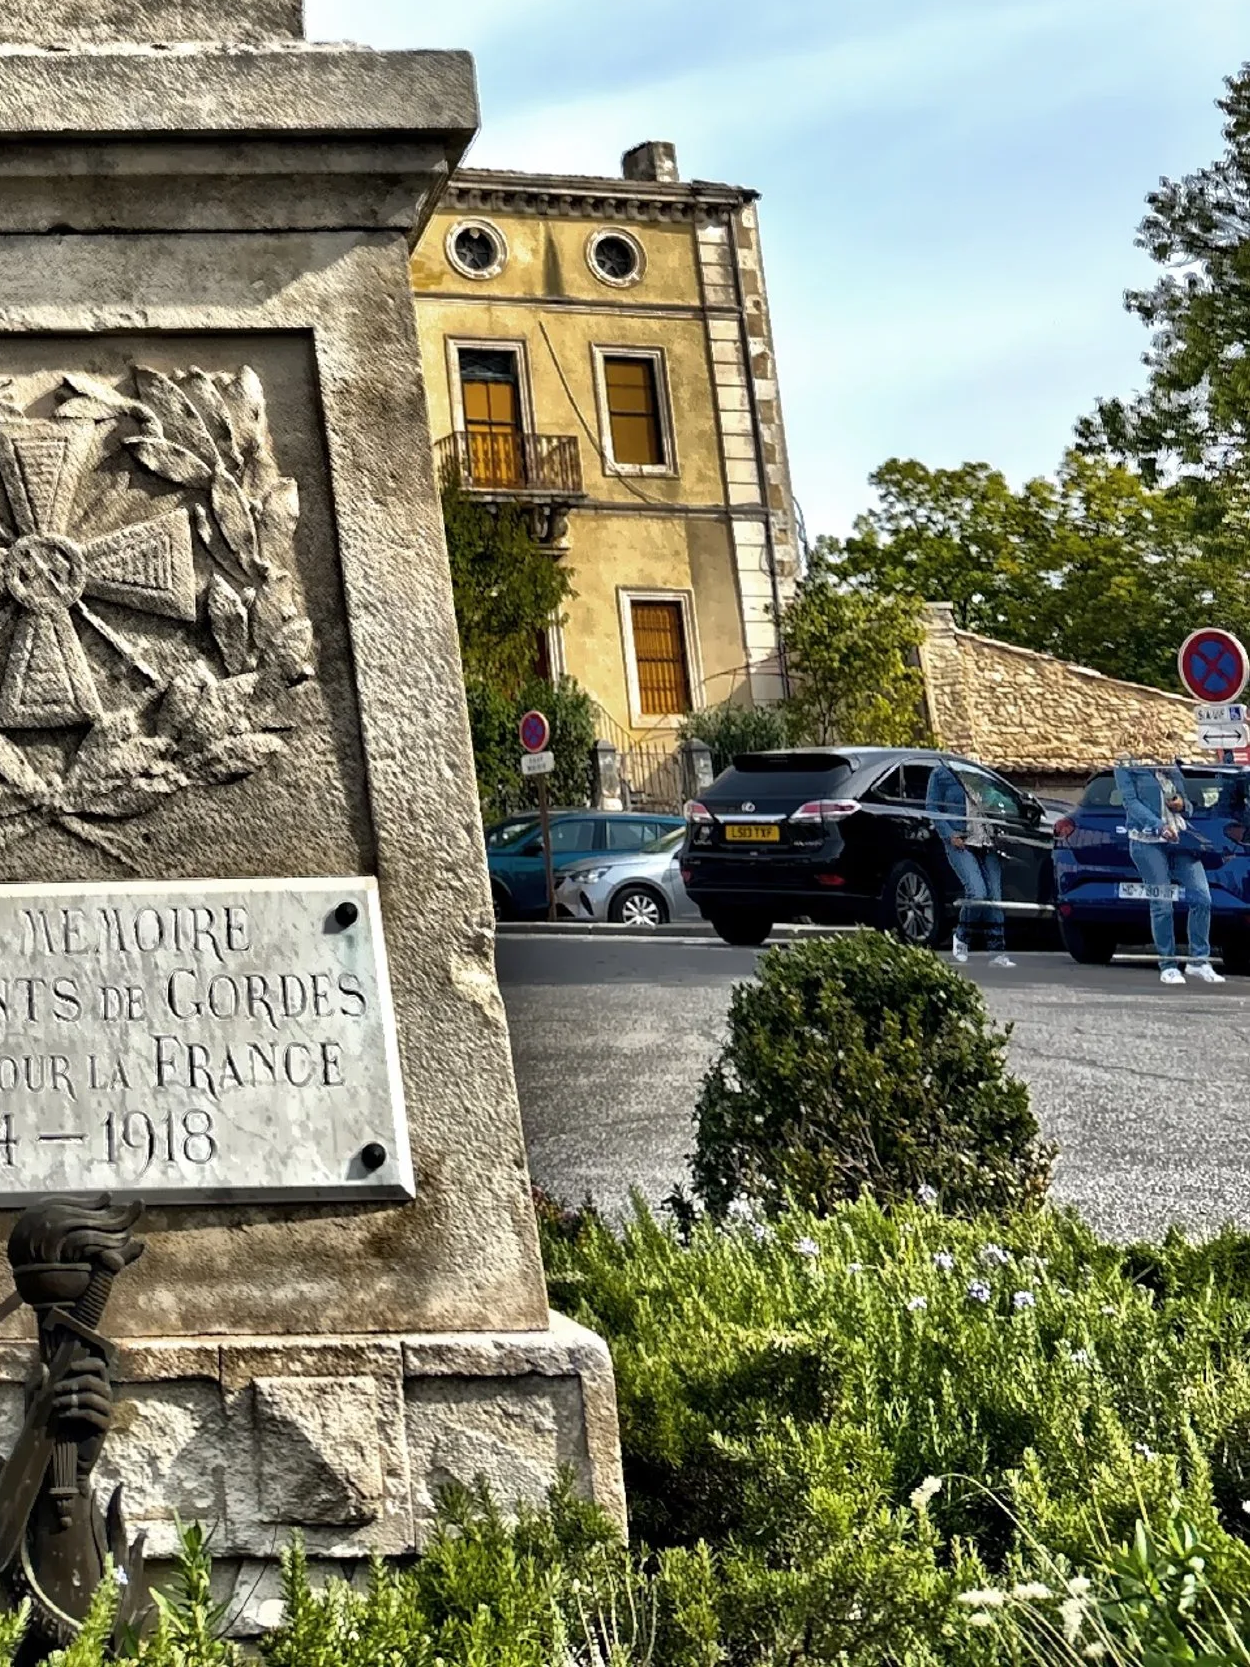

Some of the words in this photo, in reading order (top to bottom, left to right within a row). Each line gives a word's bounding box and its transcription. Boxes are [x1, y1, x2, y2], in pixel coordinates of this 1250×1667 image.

[100, 984, 146, 1023] DE
[165, 967, 368, 1031] GORDES
[88, 1053, 133, 1092] LA
[149, 1033, 347, 1102] FRANCE
[100, 1108, 218, 1178] 1918
